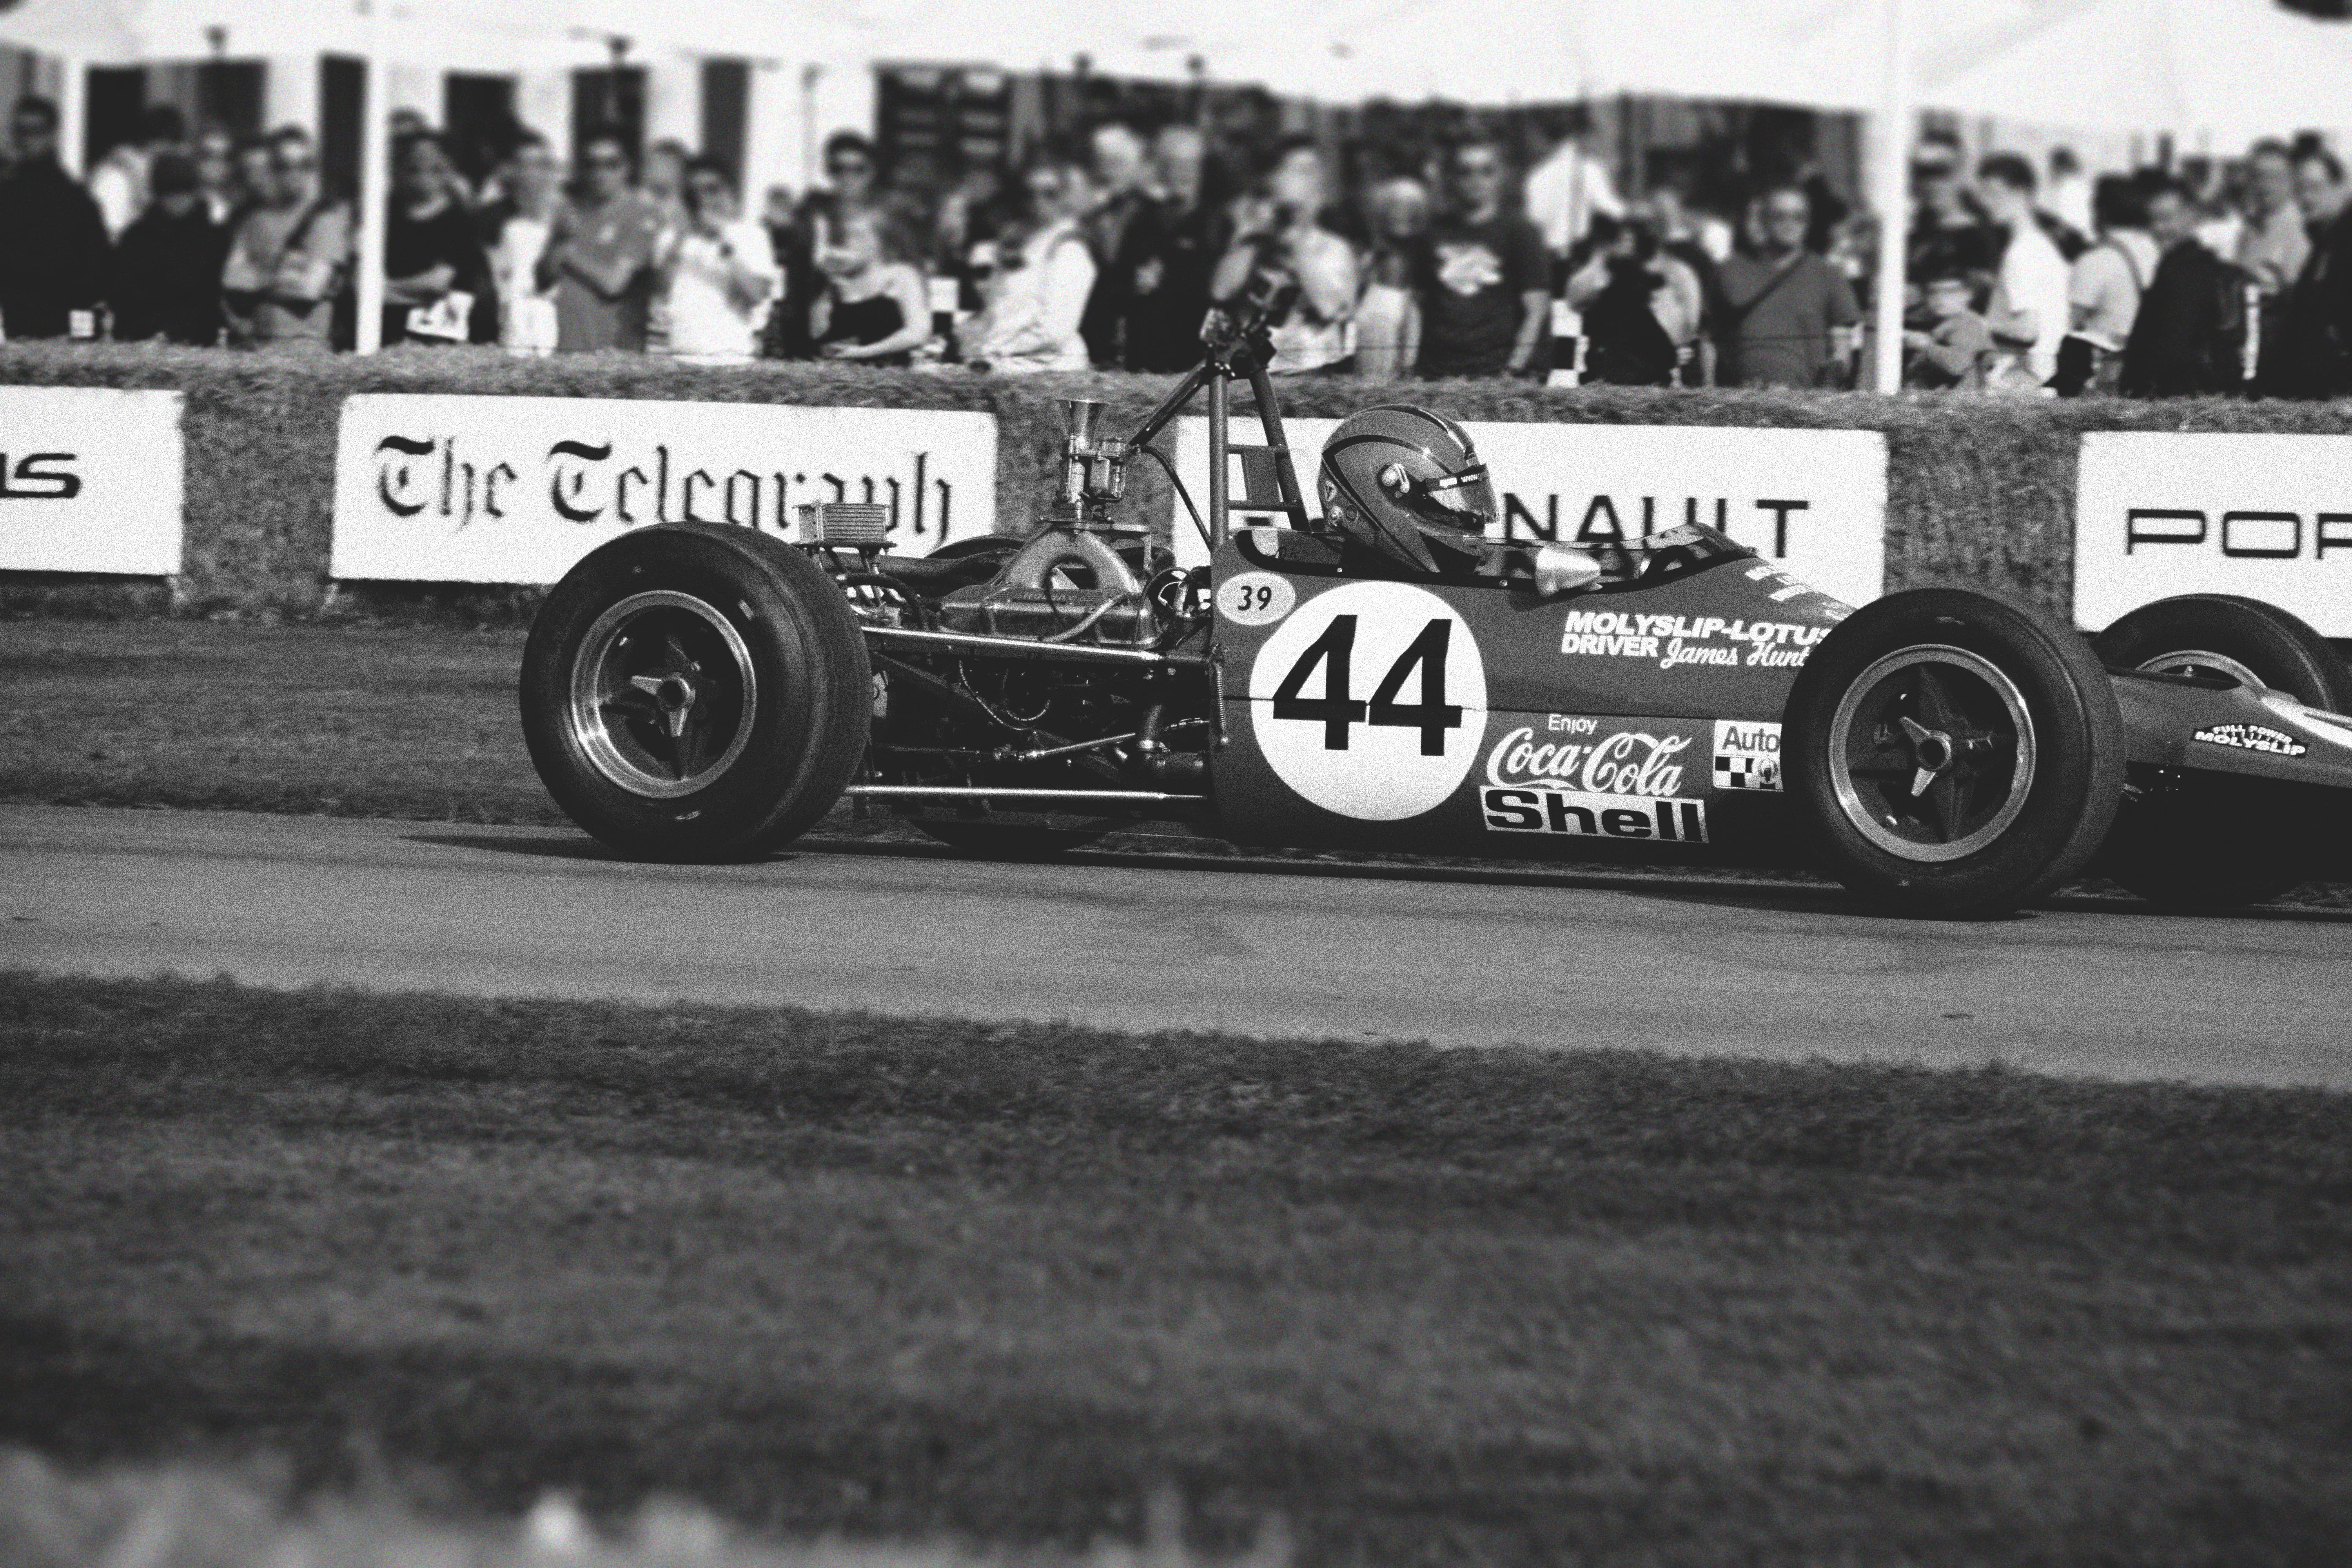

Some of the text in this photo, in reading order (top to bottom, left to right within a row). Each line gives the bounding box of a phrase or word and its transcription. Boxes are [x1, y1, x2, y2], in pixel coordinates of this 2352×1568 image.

[0, 452, 82, 500] S
[374, 435, 517, 528] The
[1237, 585, 1272, 612] 39
[1561, 633, 1810, 669] DRIVER James Hunt
[1272, 614, 1463, 757] 44
[1548, 714, 1598, 735] Enjoy
[1722, 726, 1780, 752] Auto
[2212, 724, 2293, 744] FULL POWER
[2194, 731, 2306, 756] MOLYSLIP
[1486, 727, 1693, 797] Coca-Cola
[1485, 789, 1703, 843] Shell
